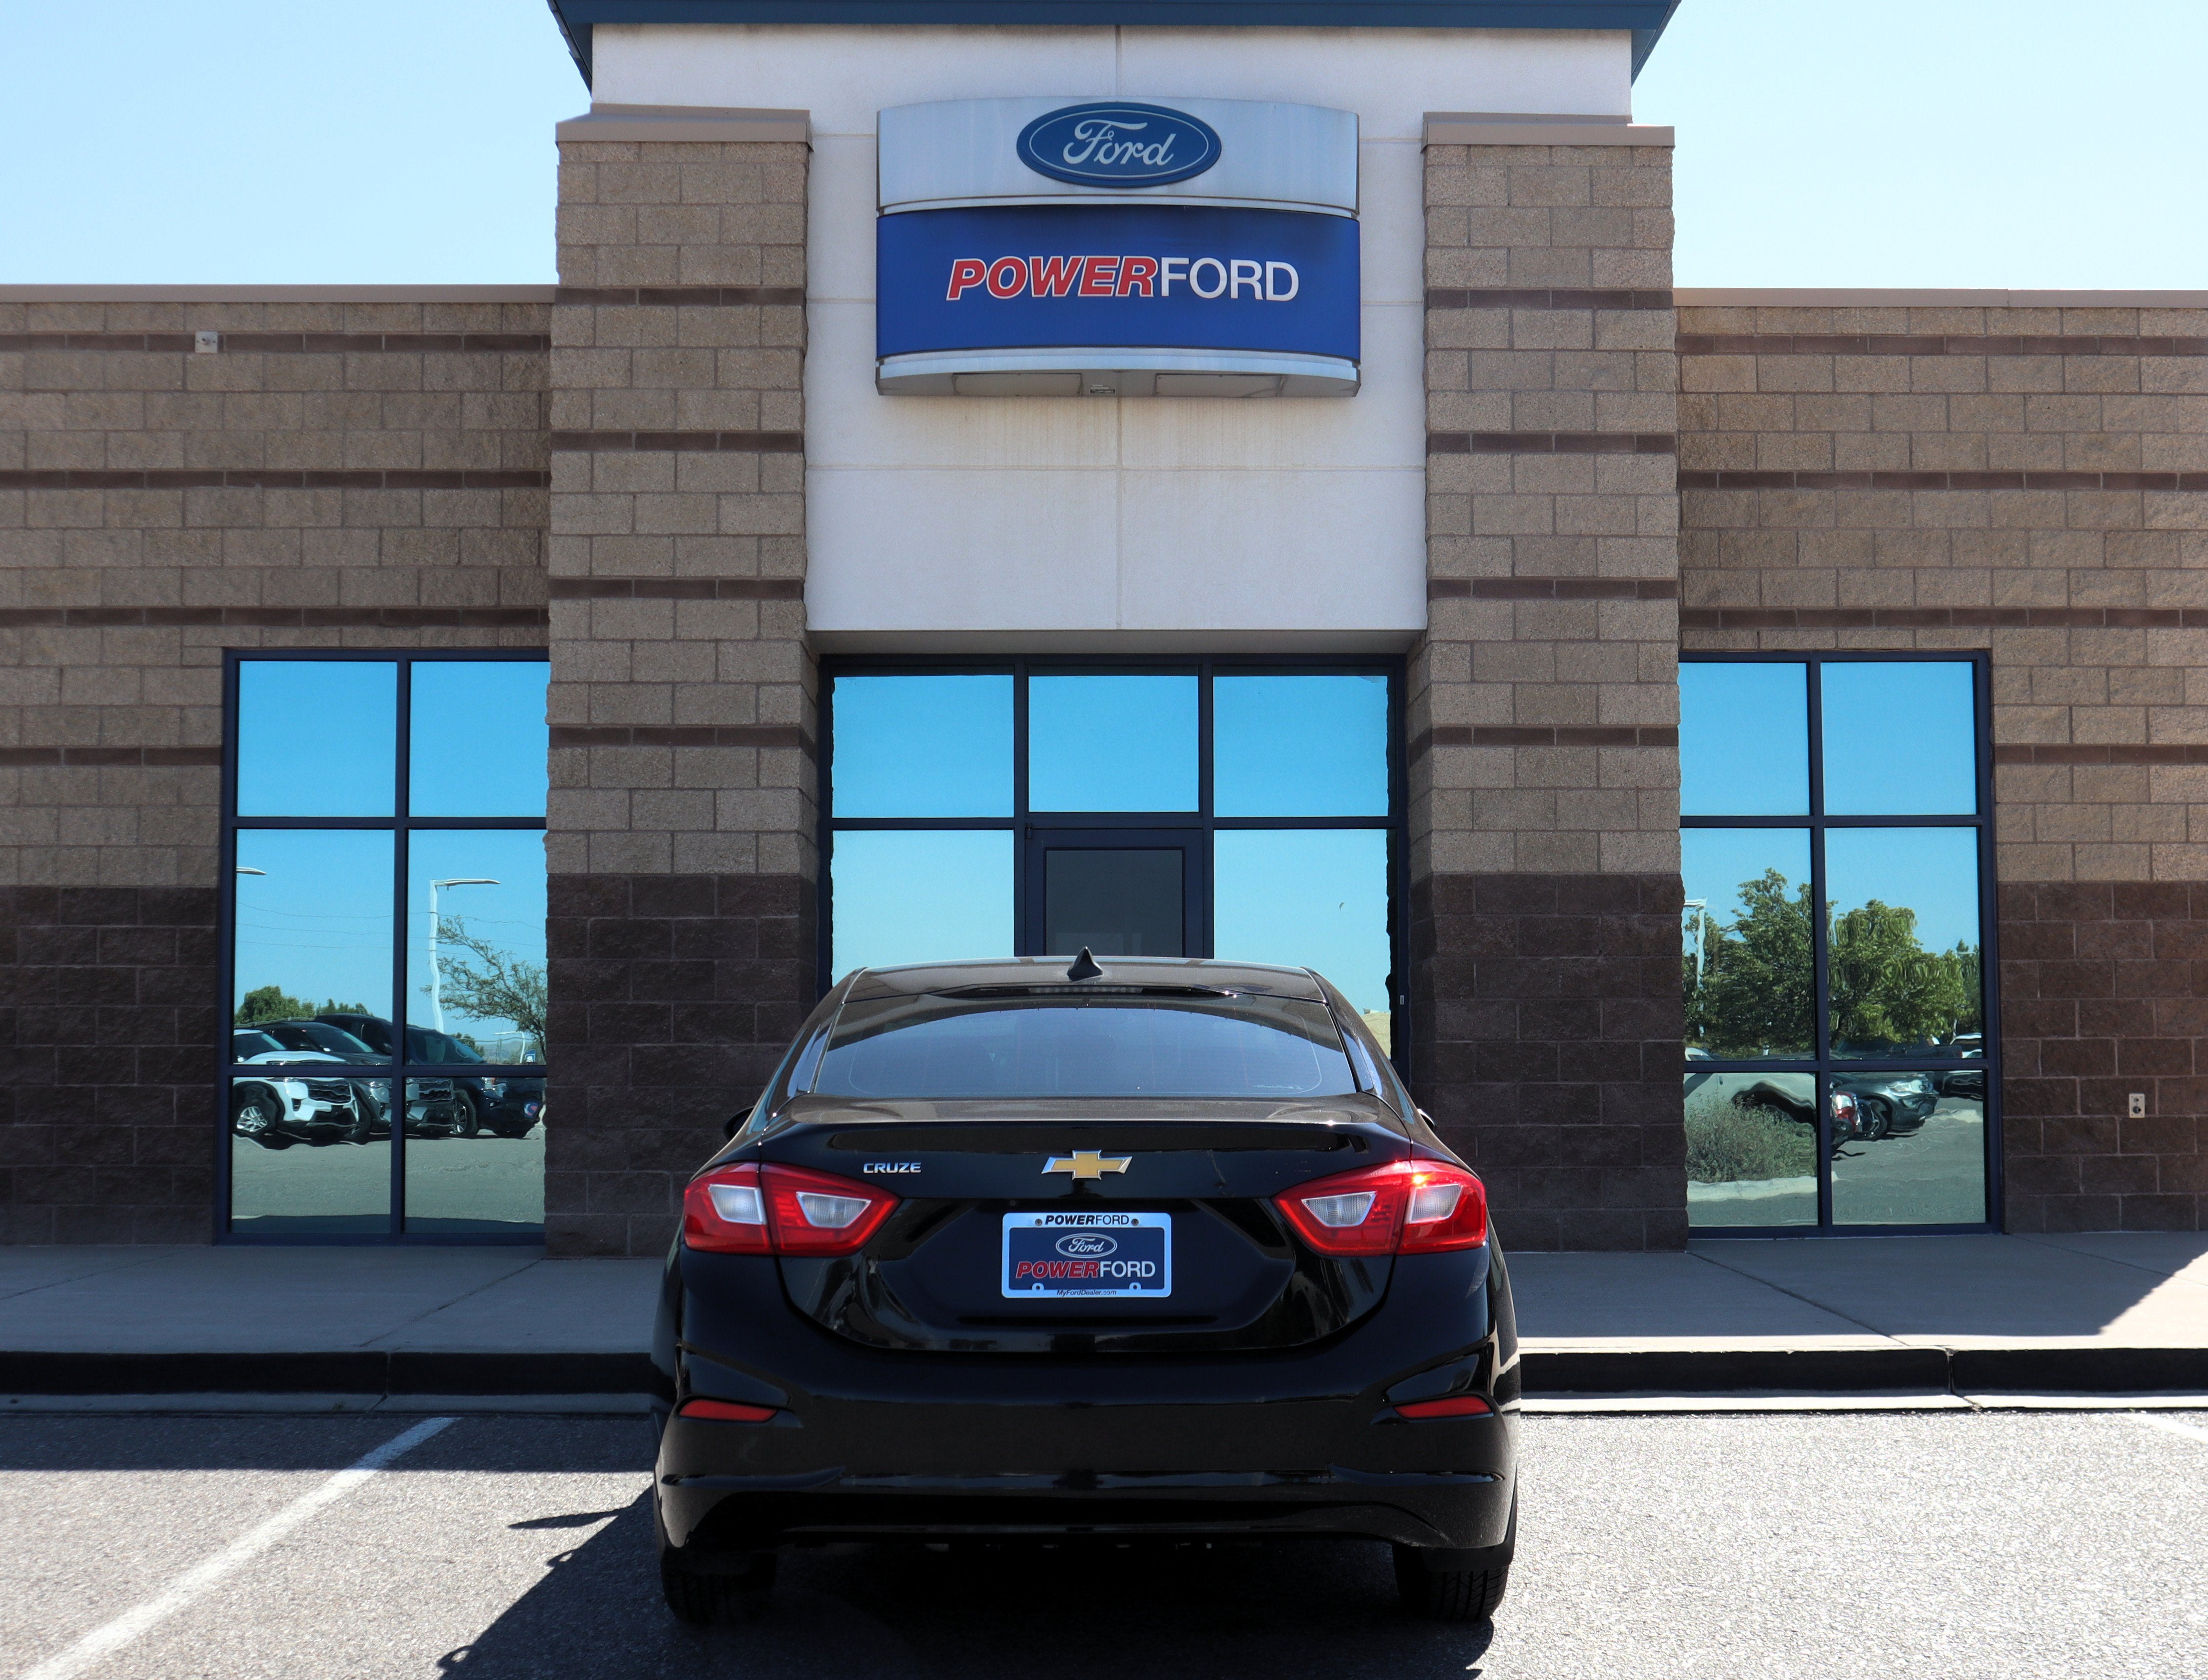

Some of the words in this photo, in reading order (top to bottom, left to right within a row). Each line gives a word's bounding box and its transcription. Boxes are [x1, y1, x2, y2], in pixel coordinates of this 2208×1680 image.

[1062, 119, 1176, 166] Ford
[863, 1162, 921, 1174] CRUZE
[1068, 1237, 1105, 1253] Ford
[1057, 1289, 1117, 1298] MyFordDealer.com
